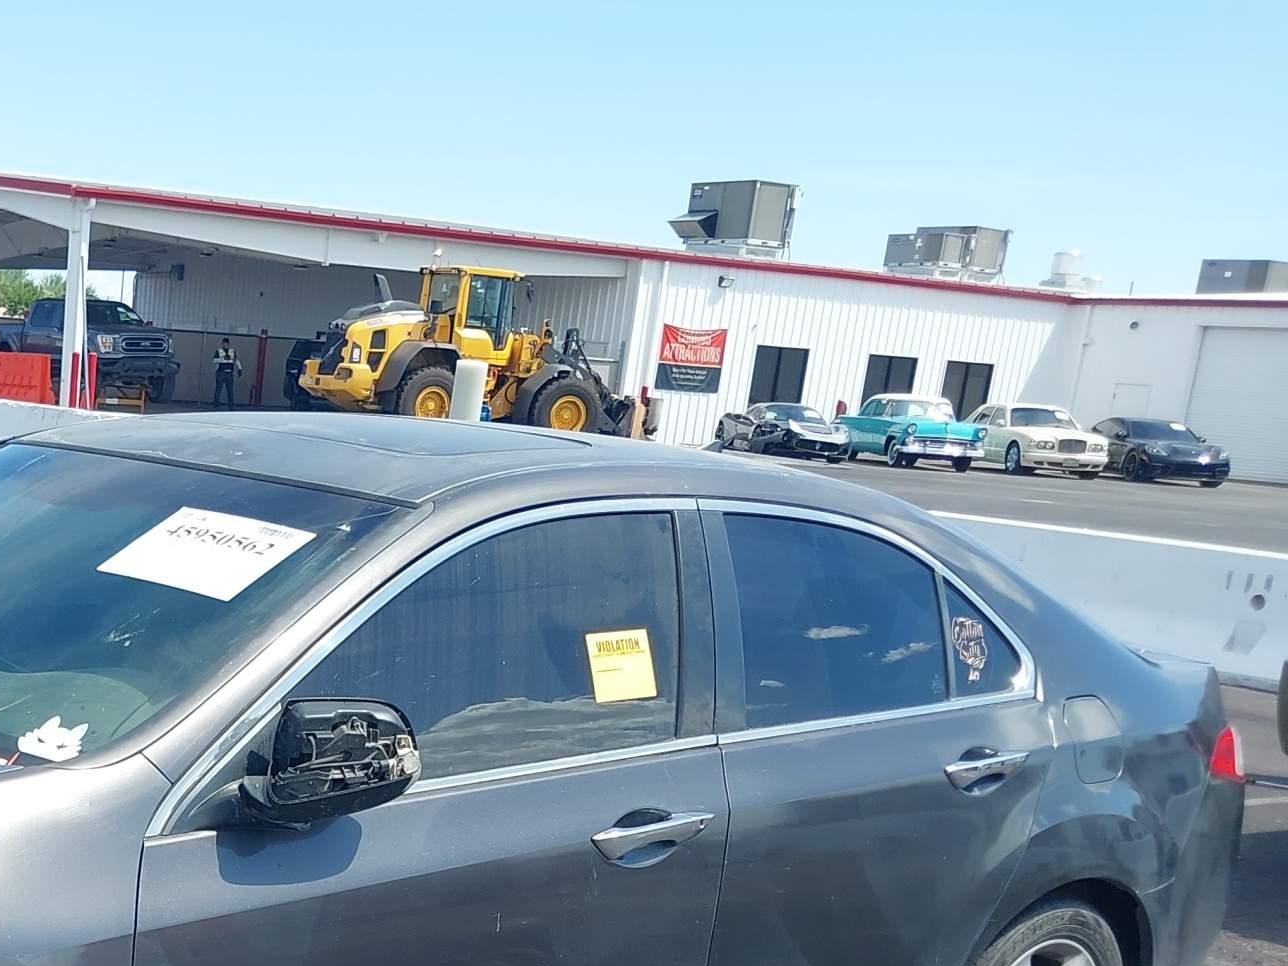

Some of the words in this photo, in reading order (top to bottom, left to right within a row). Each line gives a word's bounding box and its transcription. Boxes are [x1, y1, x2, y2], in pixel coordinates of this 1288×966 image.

[662, 343, 721, 363] ATTRACTIONS
[166, 525, 275, 555] 45950562
[596, 637, 640, 653] VIOLATION
